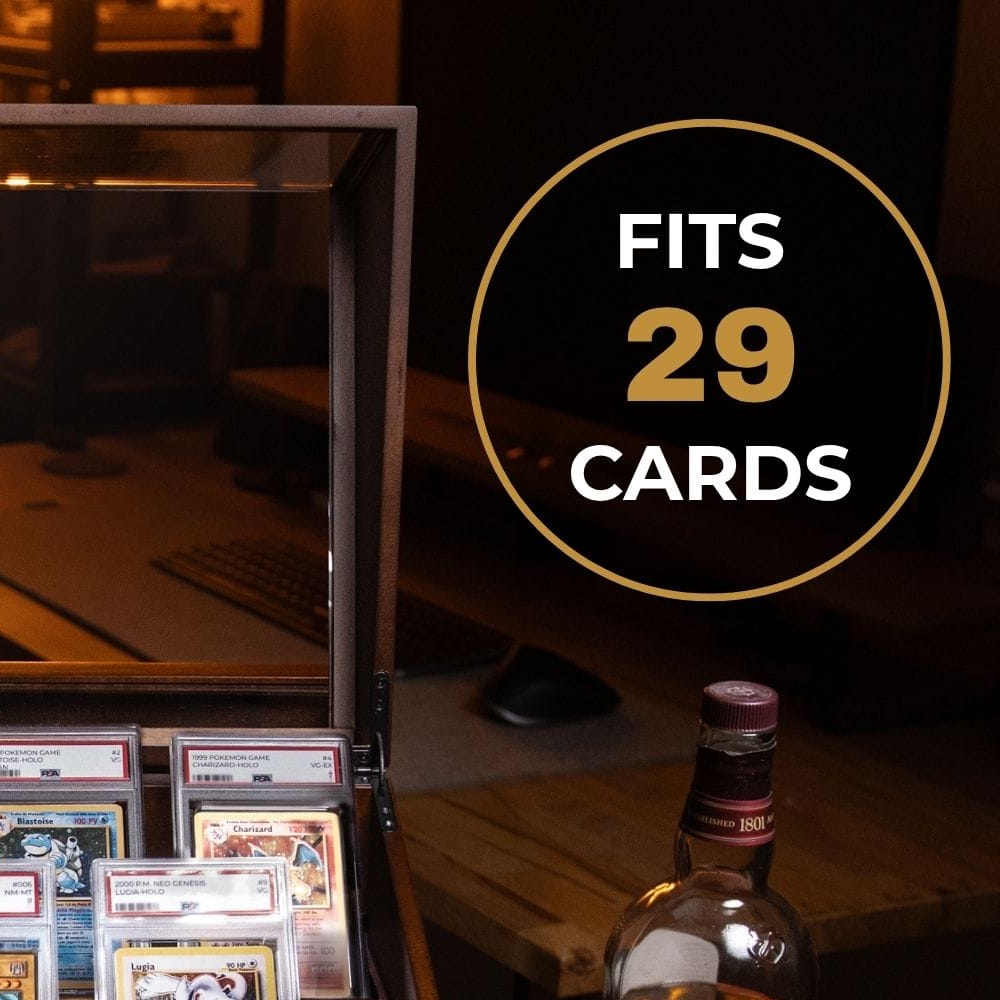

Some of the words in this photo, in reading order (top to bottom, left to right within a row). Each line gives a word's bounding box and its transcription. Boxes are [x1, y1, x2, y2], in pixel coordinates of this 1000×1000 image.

[253, 775, 272, 783] PSA
[17, 817, 54, 825] Blastoise
[739, 815, 766, 832] 1801
[233, 825, 273, 833] Charizard
[131, 963, 155, 972] Lugia
